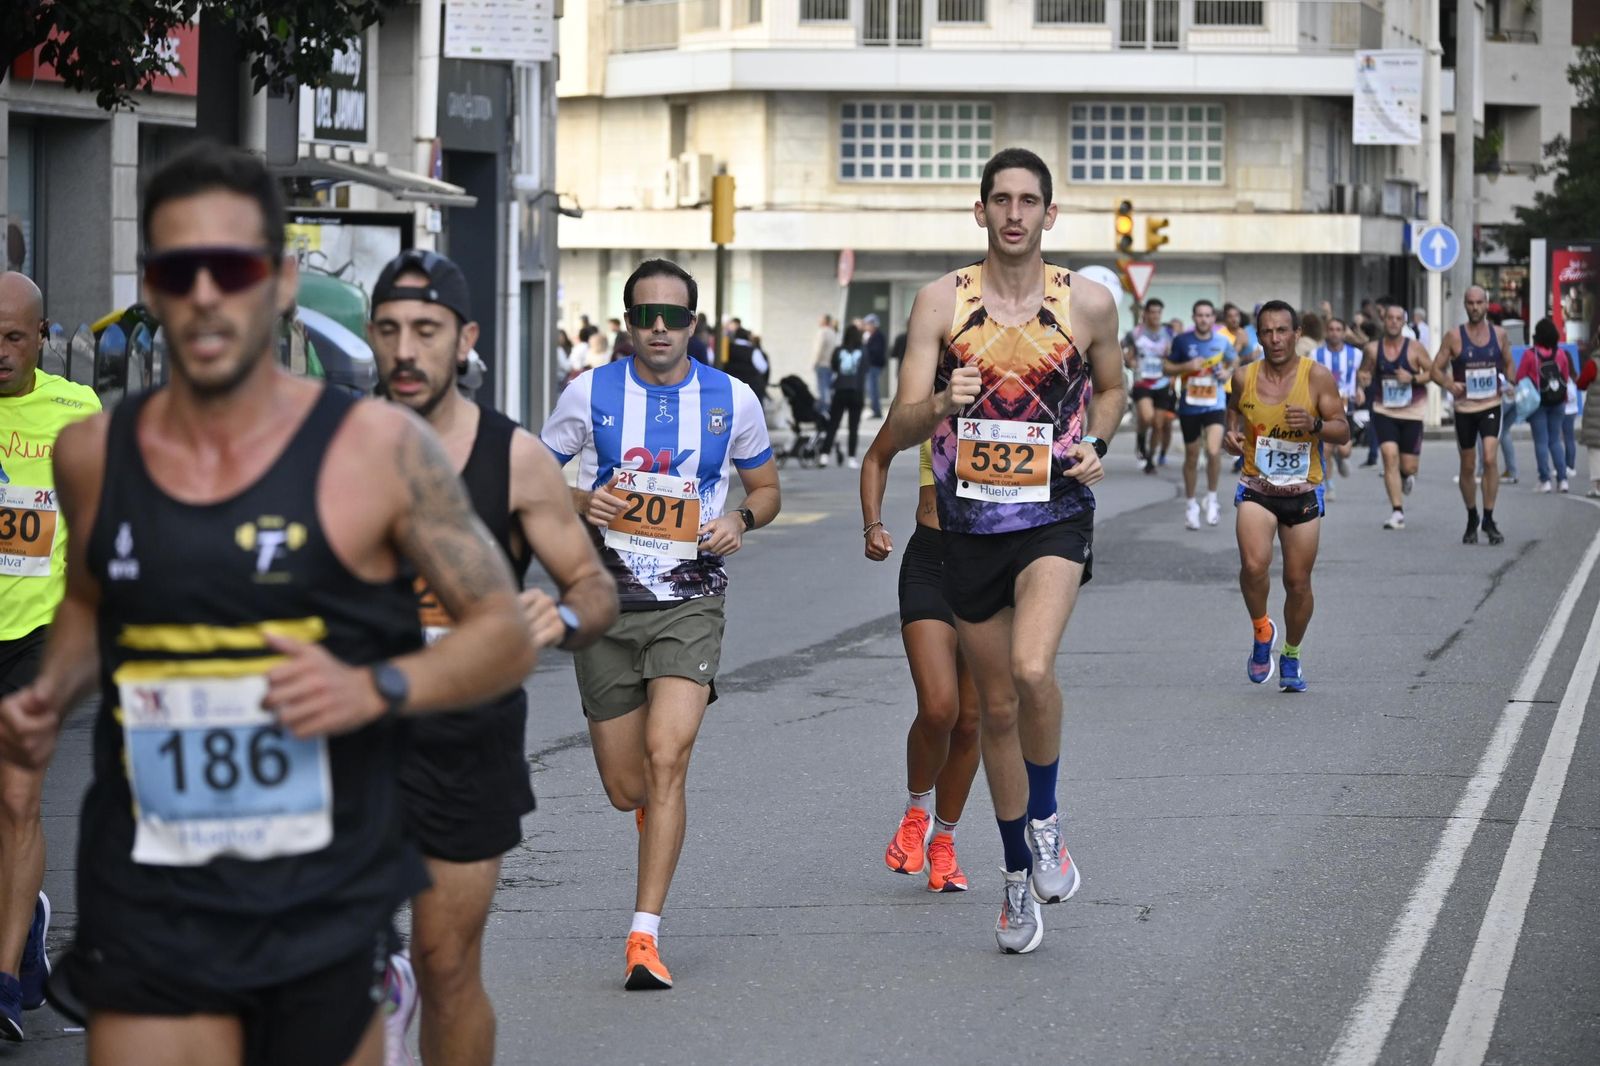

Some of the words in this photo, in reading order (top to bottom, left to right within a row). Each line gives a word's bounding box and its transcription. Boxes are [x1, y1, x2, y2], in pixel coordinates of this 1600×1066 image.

[623, 447, 696, 477] 21K
[971, 442, 1034, 475] 532
[1265, 450, 1300, 469] 138
[980, 485, 1018, 497] Huelva
[623, 492, 685, 528] 201
[629, 535, 669, 551] Huelva
[158, 727, 290, 793] 186
